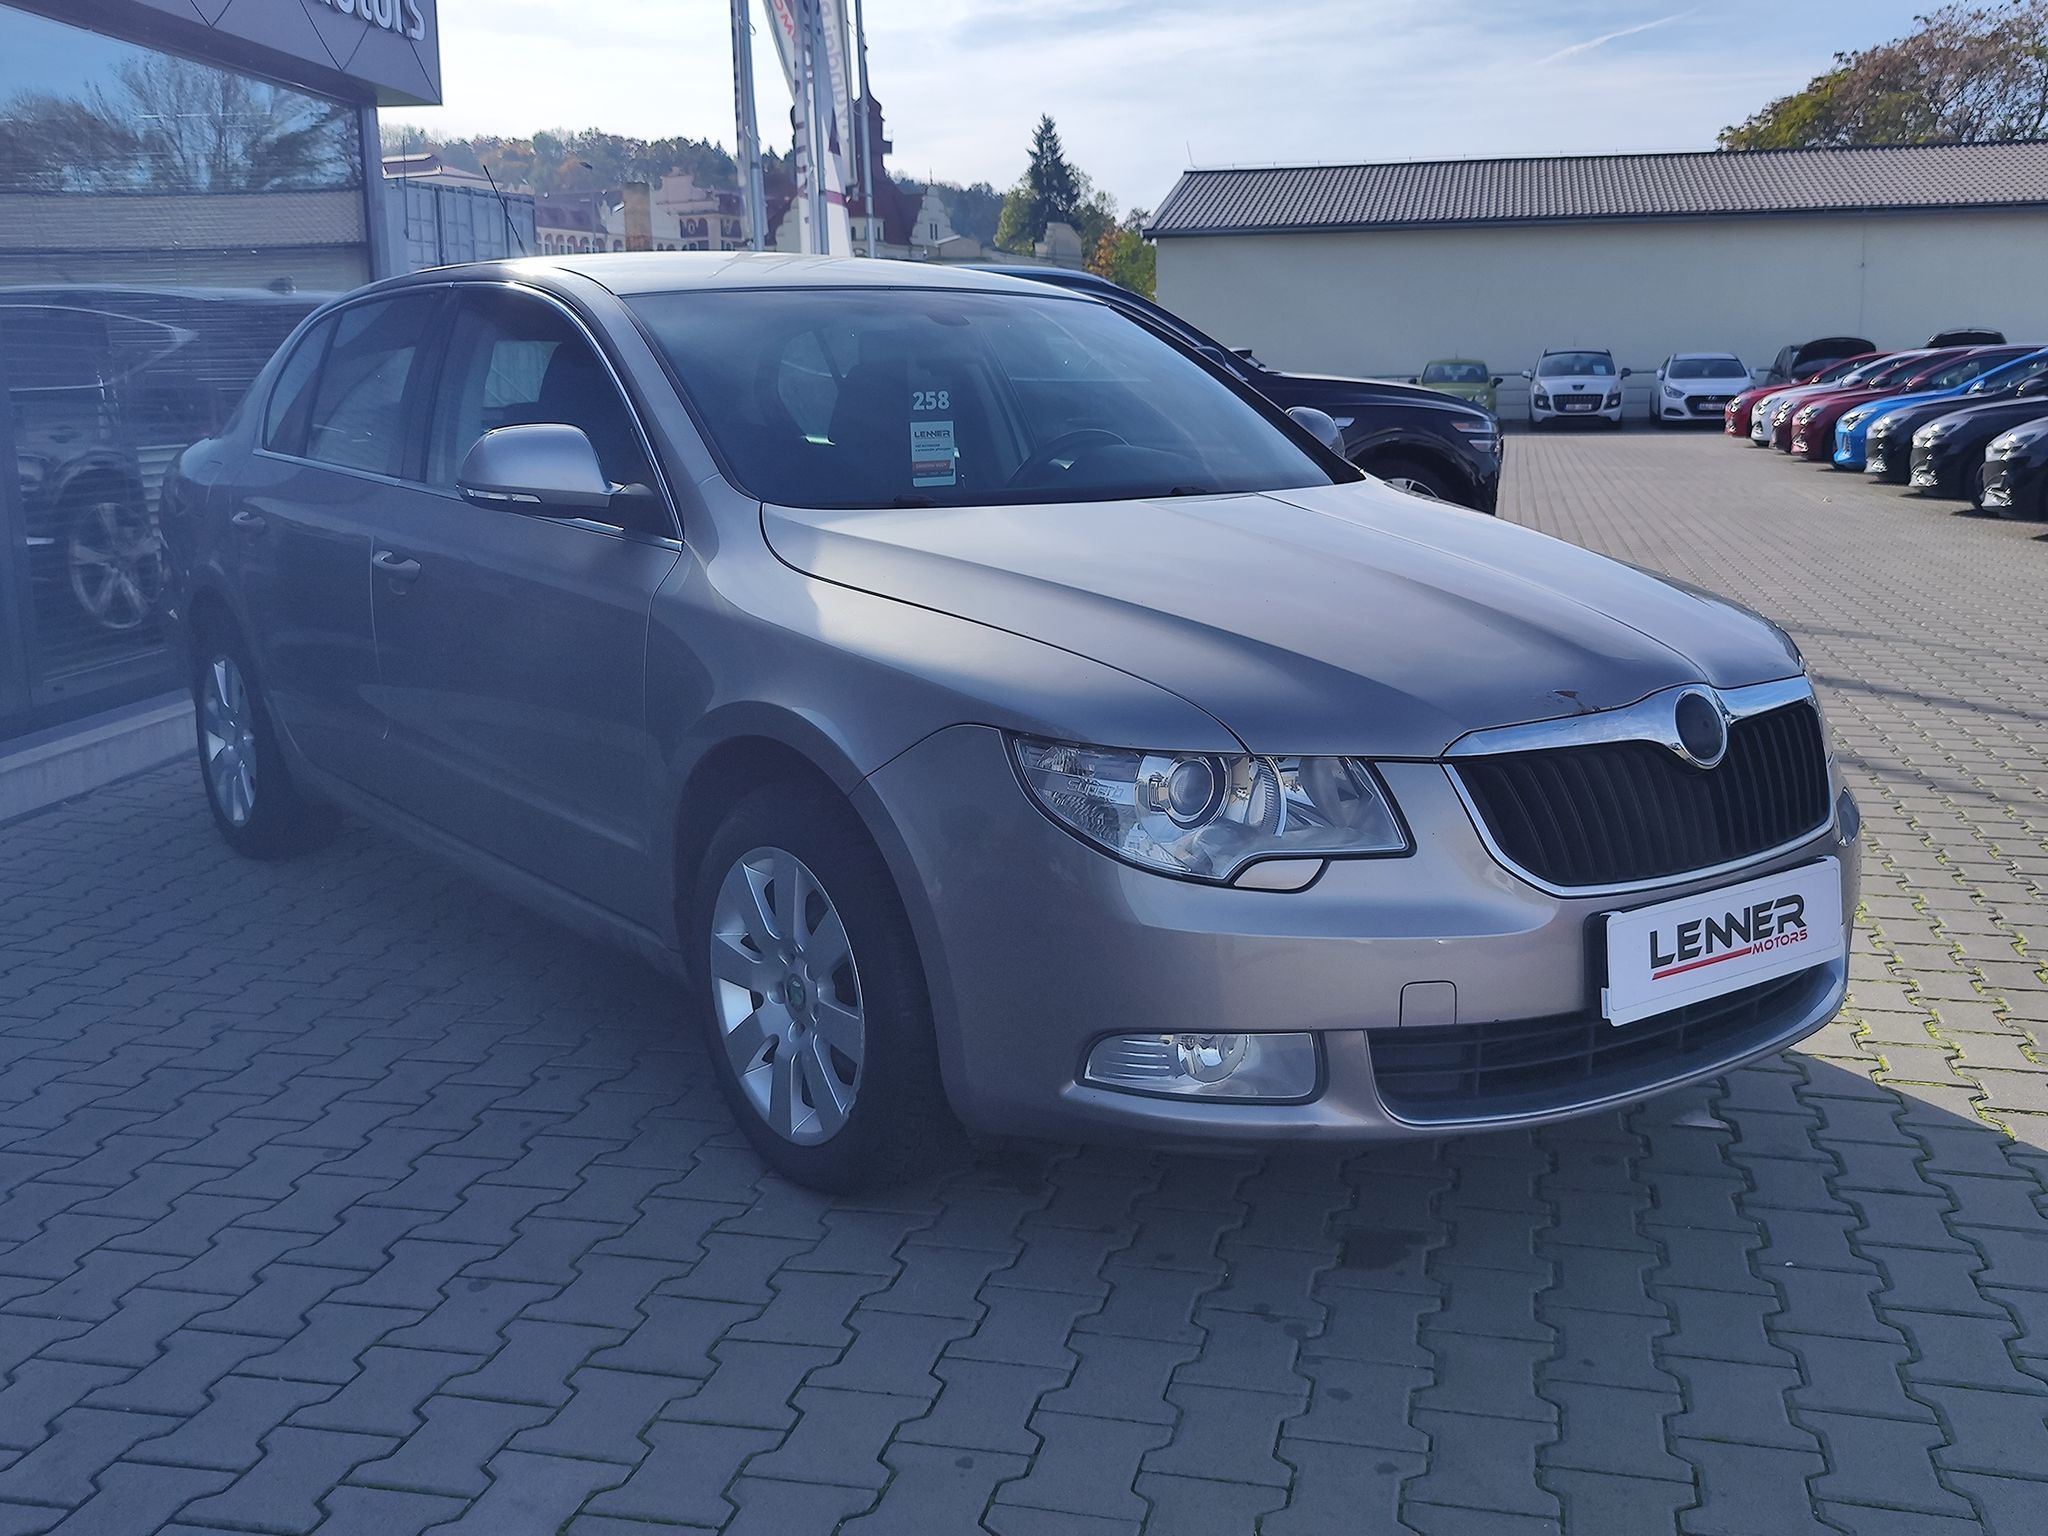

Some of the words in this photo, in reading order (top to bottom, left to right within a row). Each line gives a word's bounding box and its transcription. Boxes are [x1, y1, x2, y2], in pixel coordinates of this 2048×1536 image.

[912, 390, 950, 411] 258
[914, 429, 951, 439] LENNER
[1650, 894, 1807, 969] LENNER
[1751, 928, 1808, 955] MOTORS
